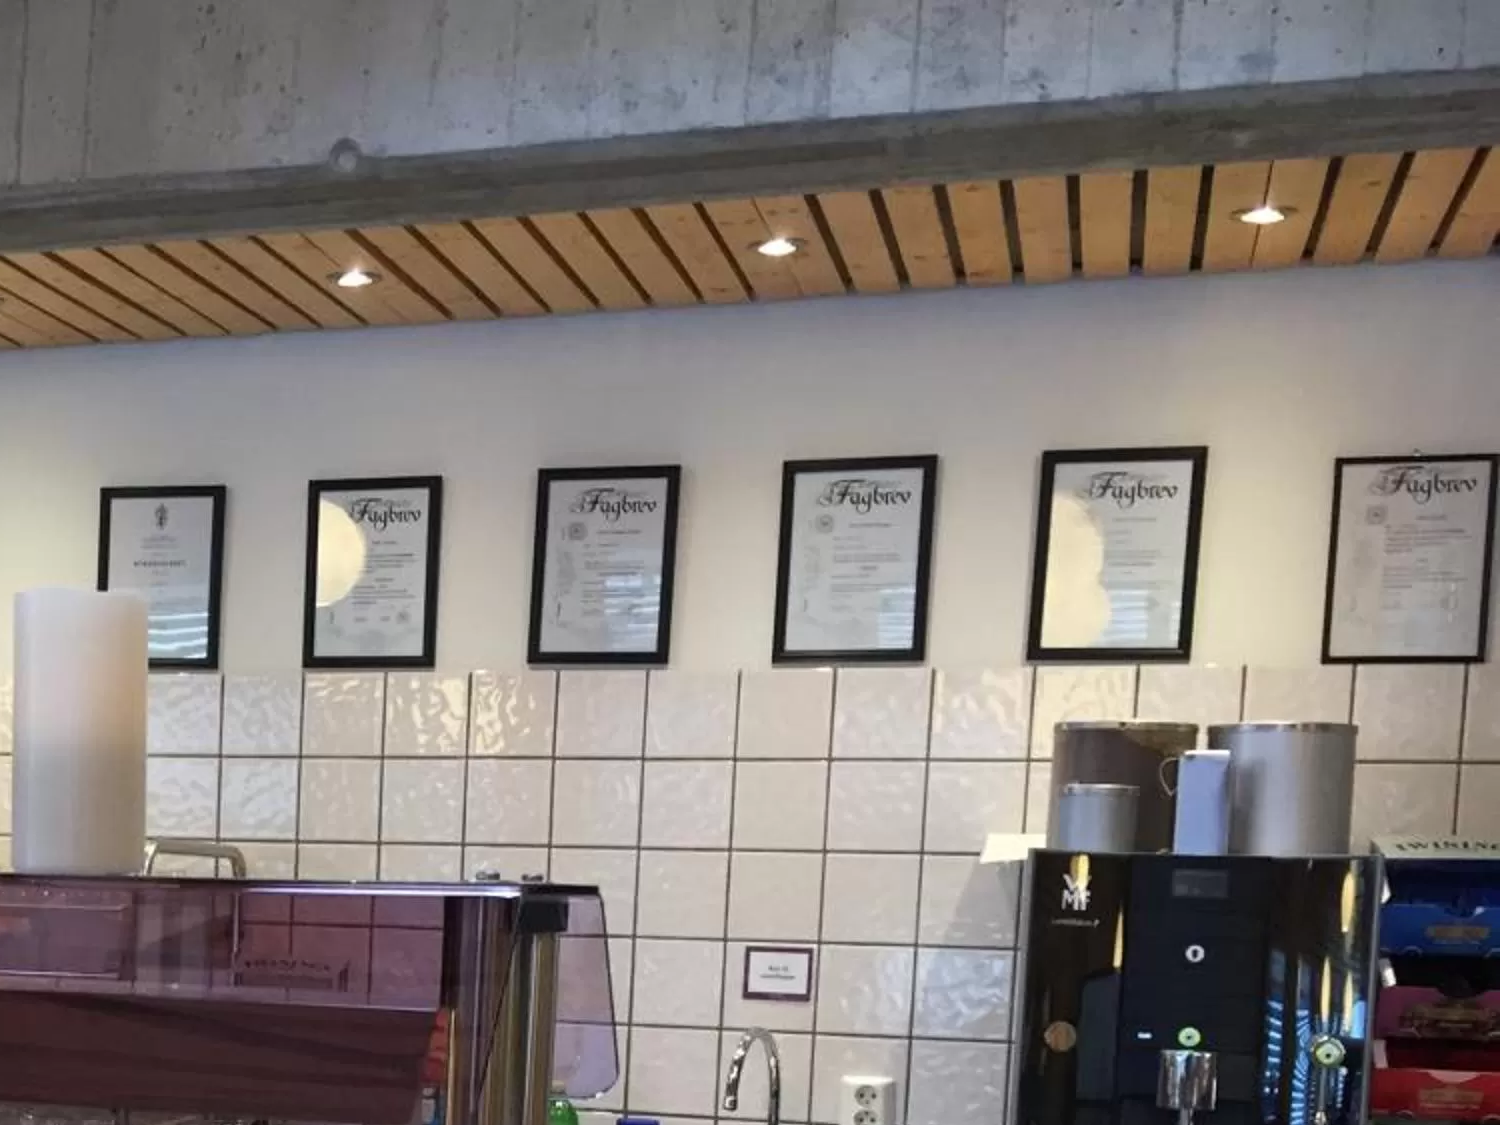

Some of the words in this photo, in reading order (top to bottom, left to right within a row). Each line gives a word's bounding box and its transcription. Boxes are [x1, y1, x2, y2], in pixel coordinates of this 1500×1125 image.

[817, 479, 912, 515] Fagbrev
[1088, 471, 1179, 509] Fagbrev
[1368, 465, 1477, 505] Fagbrev
[350, 497, 422, 532] Fagbrev
[570, 487, 657, 522] Fagbrev
